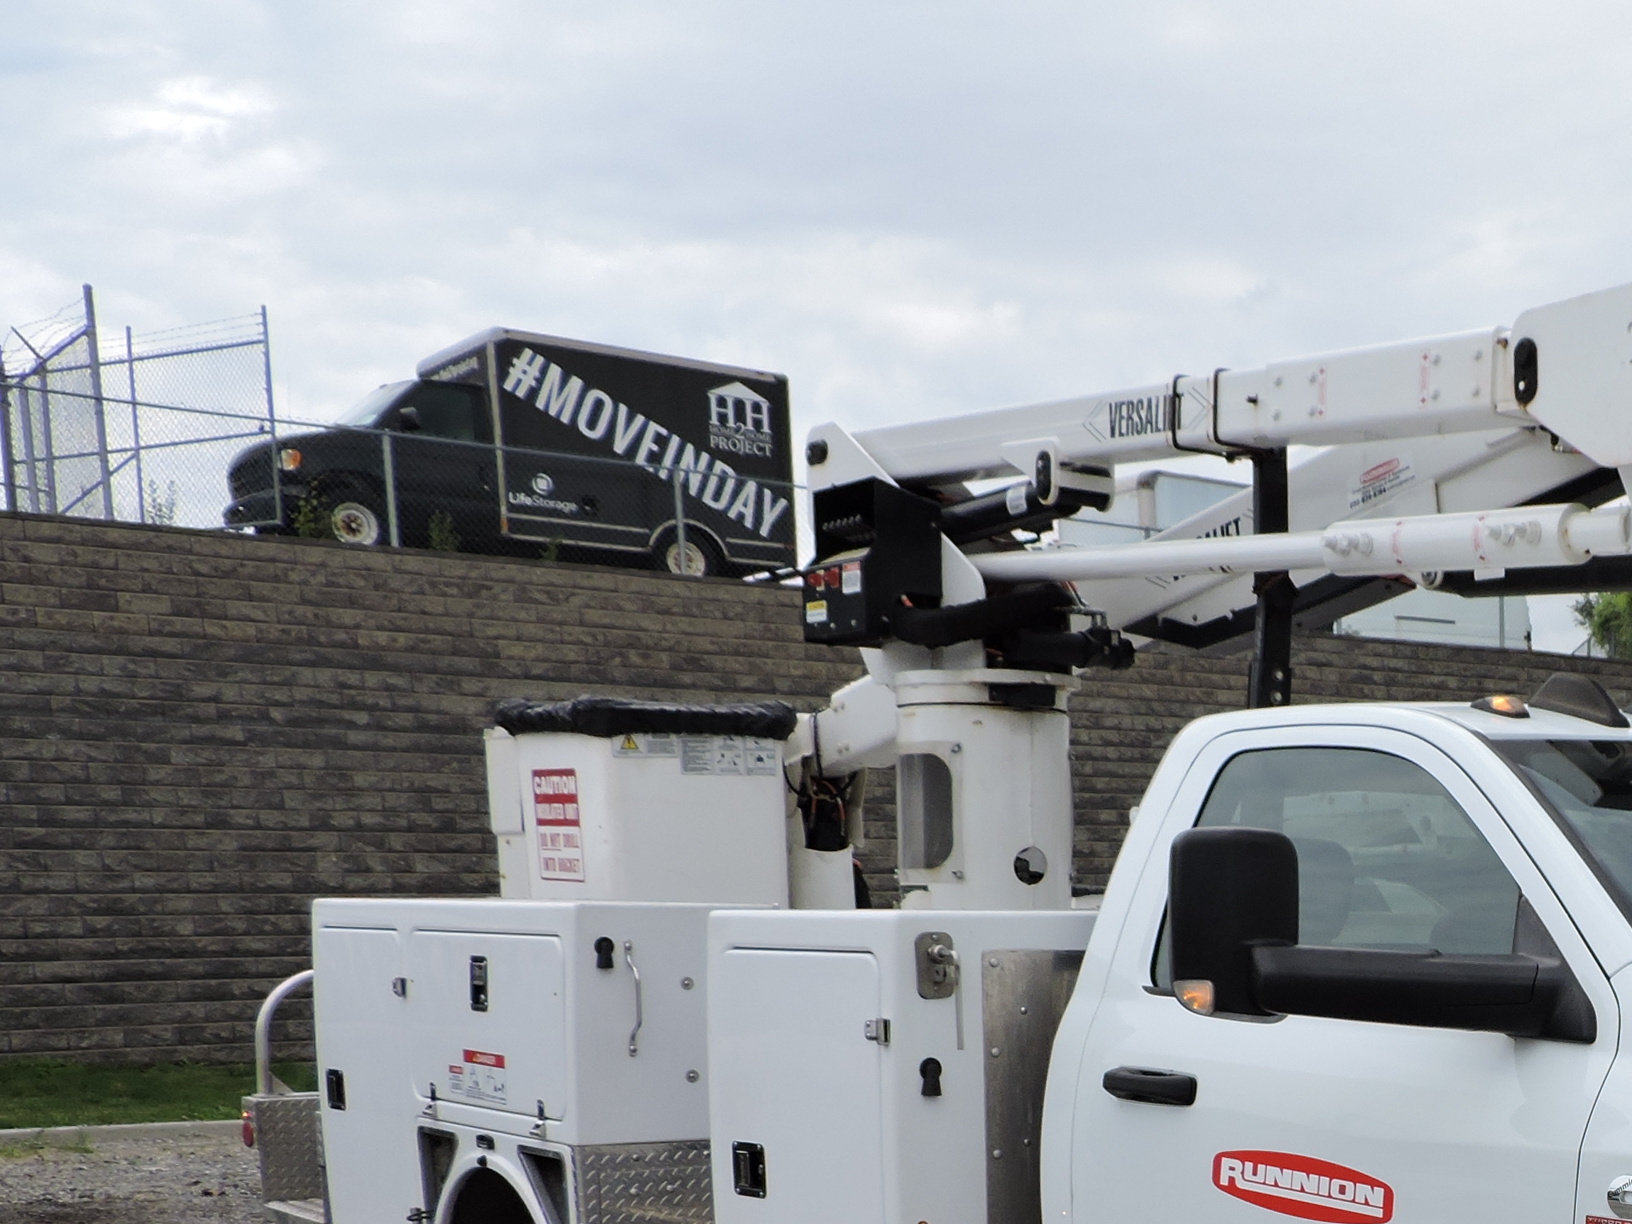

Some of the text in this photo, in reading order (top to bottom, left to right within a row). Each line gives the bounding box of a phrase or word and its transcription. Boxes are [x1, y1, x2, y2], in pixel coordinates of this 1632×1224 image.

[503, 347, 789, 539] #MOVEINDAY
[710, 435, 773, 457] PROJECT
[534, 776, 577, 795] CAUTION
[1219, 1156, 1385, 1210] RUNNION
